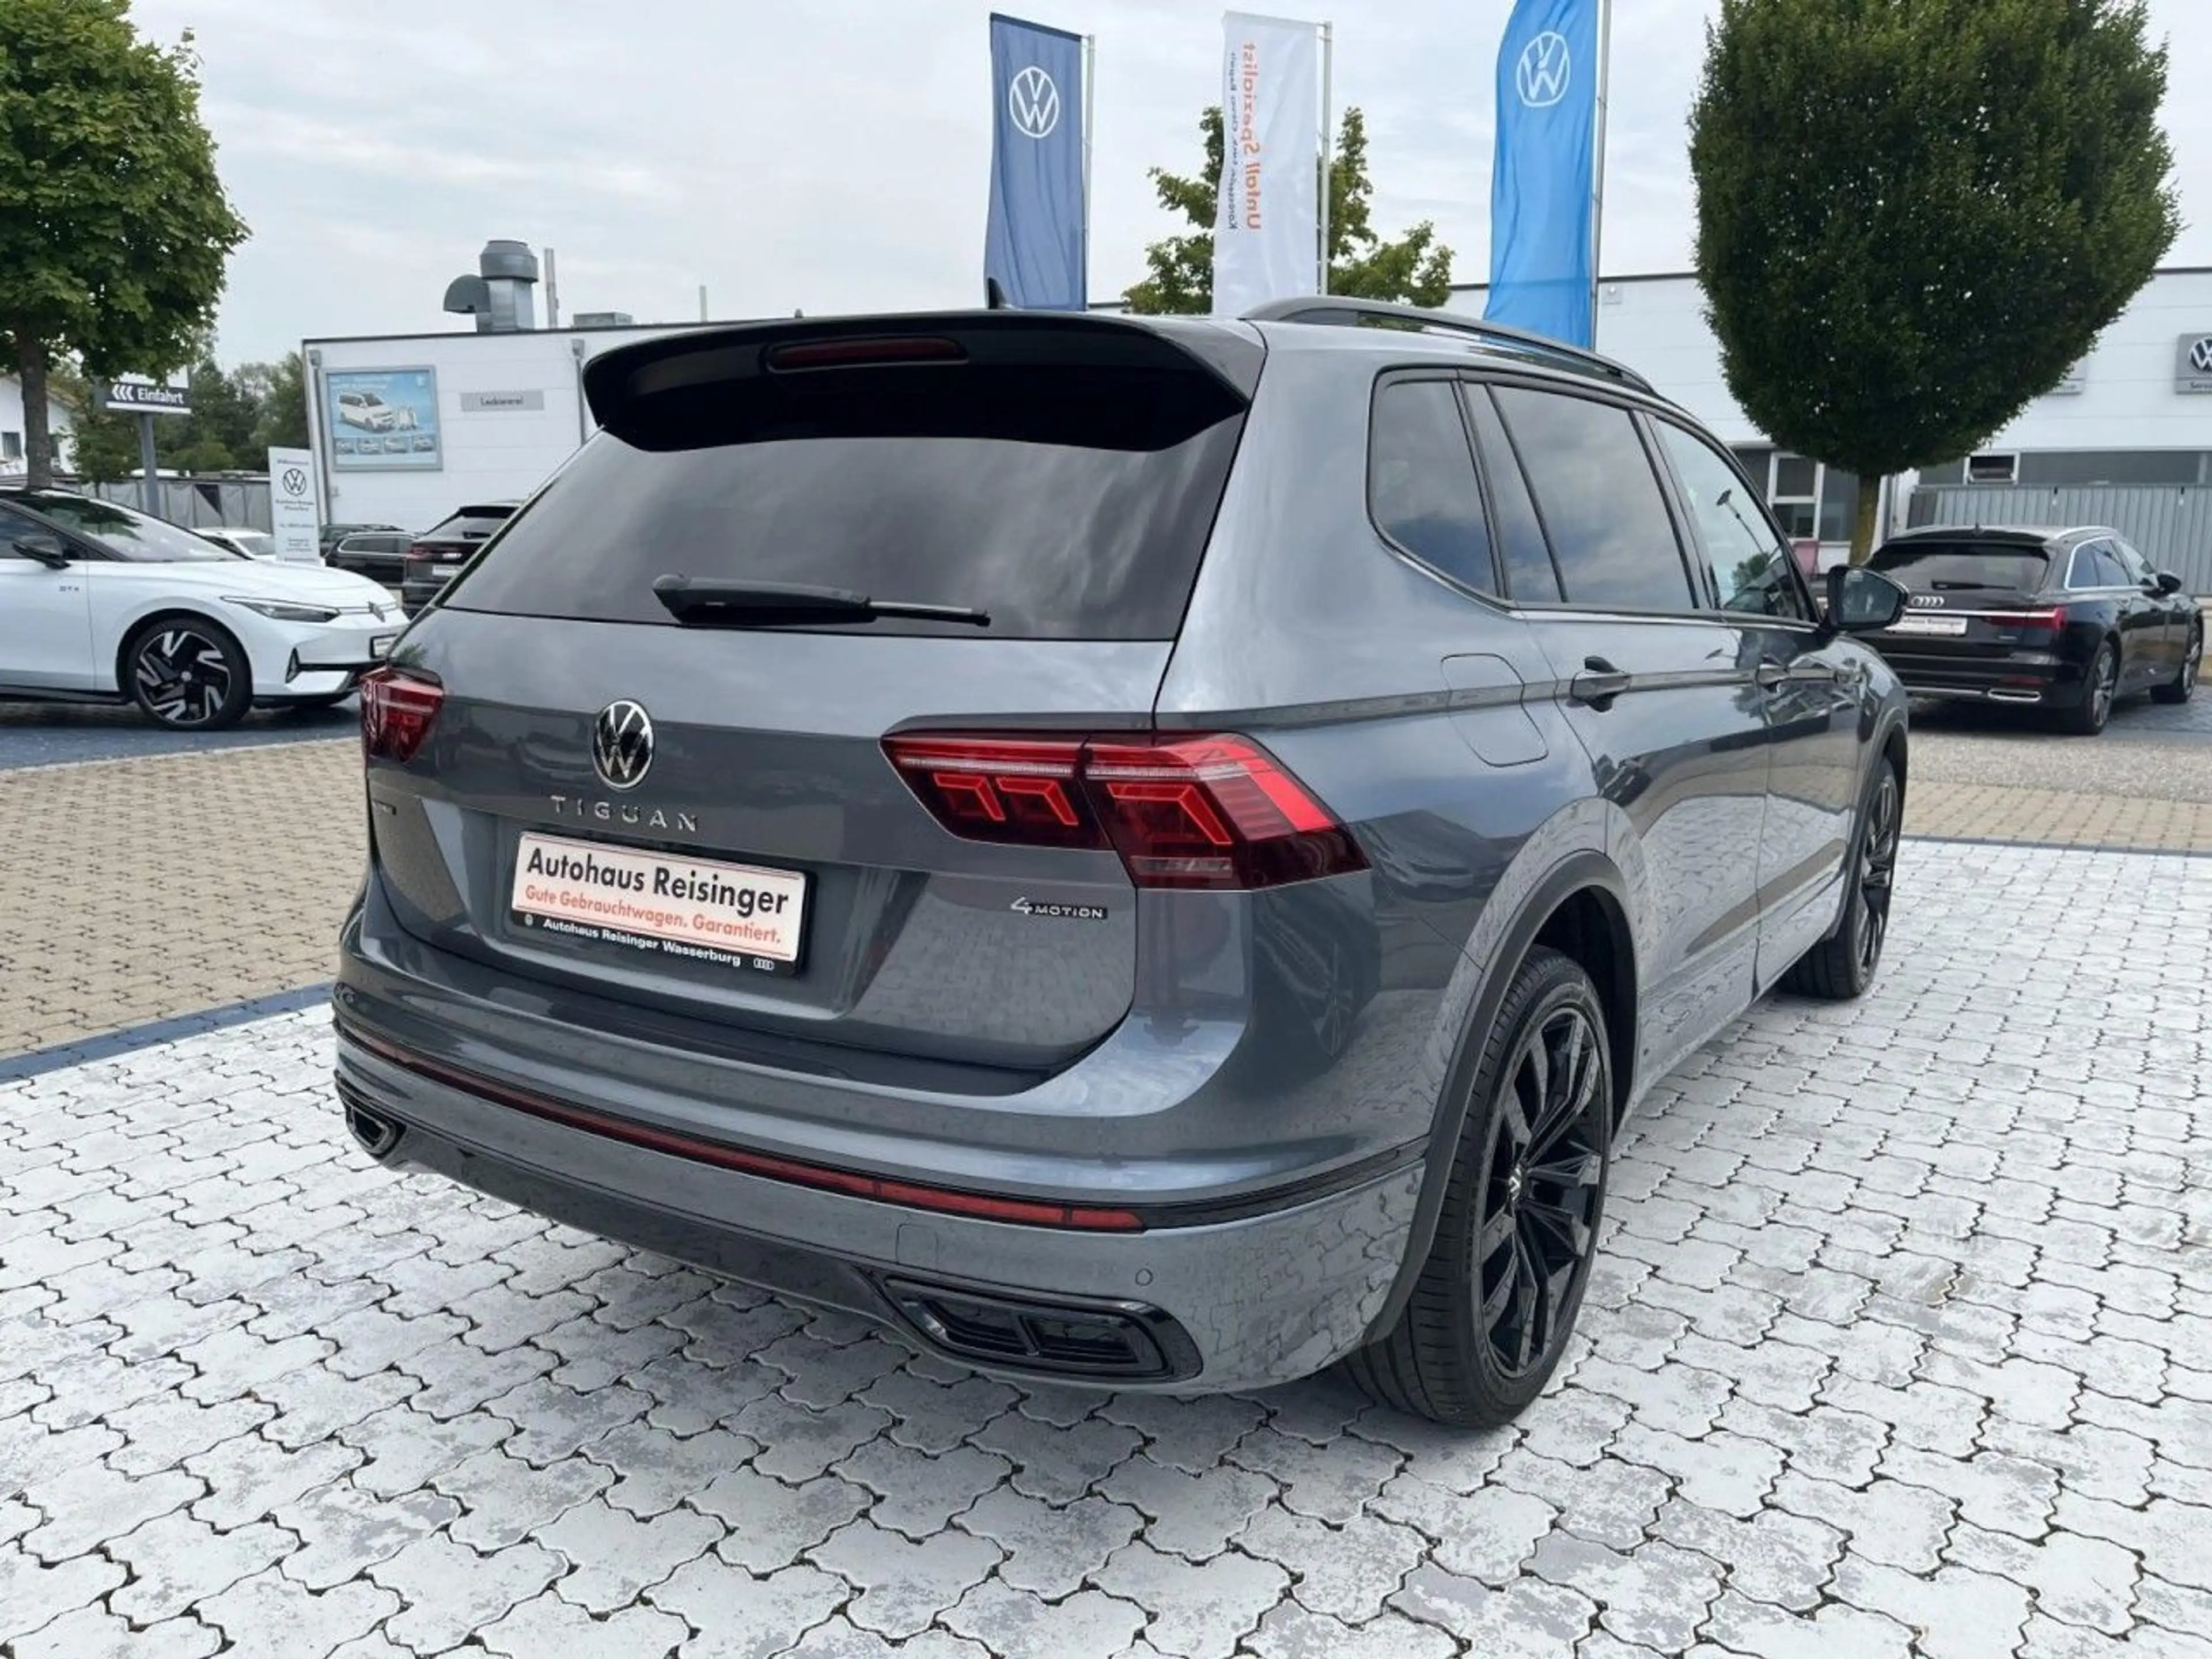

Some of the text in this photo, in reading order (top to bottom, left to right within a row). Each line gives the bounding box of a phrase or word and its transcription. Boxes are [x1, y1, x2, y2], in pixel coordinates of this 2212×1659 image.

[137, 387, 184, 404] Einfahrt
[551, 794, 697, 832] TIGUAN
[527, 847, 789, 918] Autohaus Reisinger
[525, 884, 781, 944] Gute Gebrauchtwagen. Garantiert.
[1010, 896, 1103, 919] 4MOTION
[543, 918, 741, 967] Autohaus Reisinger Wasserburg
